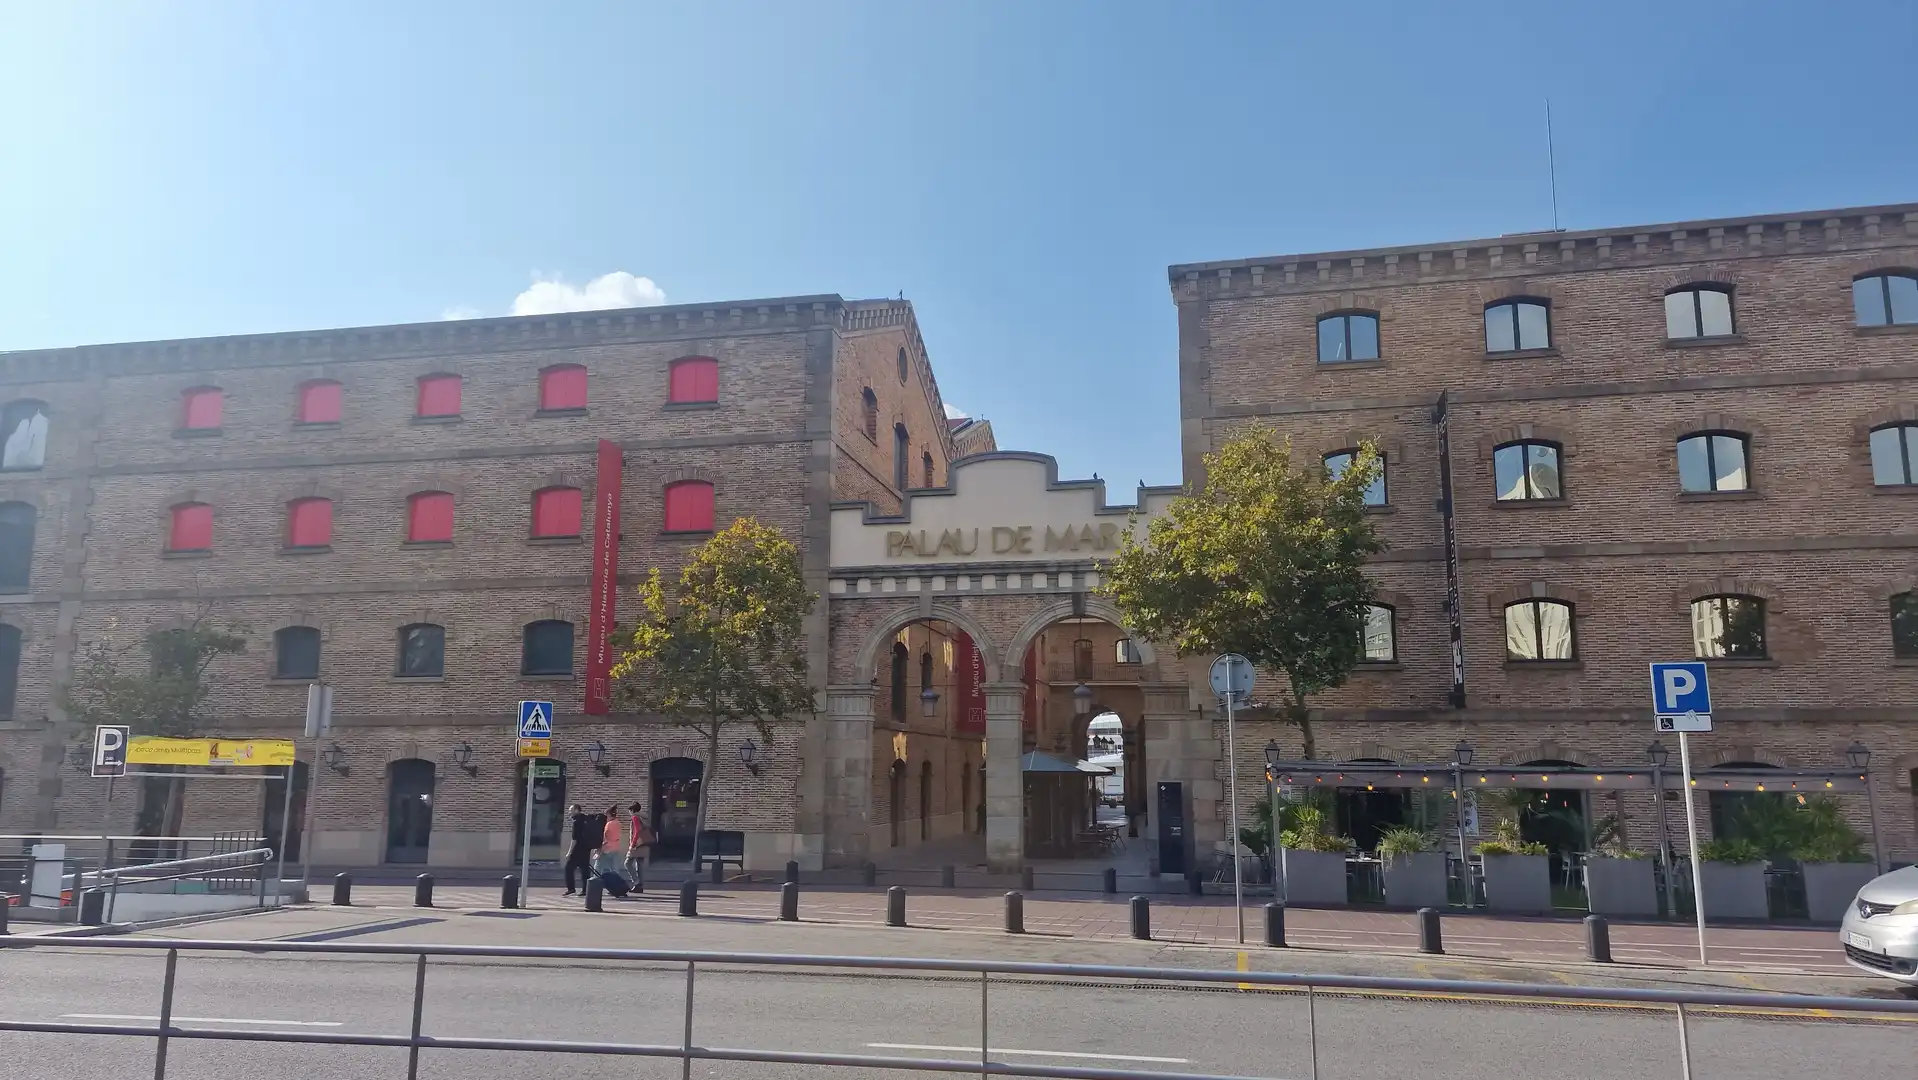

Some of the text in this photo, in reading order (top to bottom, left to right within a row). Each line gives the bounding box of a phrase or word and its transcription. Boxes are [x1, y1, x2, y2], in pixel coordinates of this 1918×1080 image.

[887, 522, 1120, 557] PALAU DE MAR
[598, 493, 613, 664] Museu d'Història de Catalunya
[971, 669, 980, 697] Museu
[1663, 669, 1697, 708] P
[96, 728, 123, 766] P
